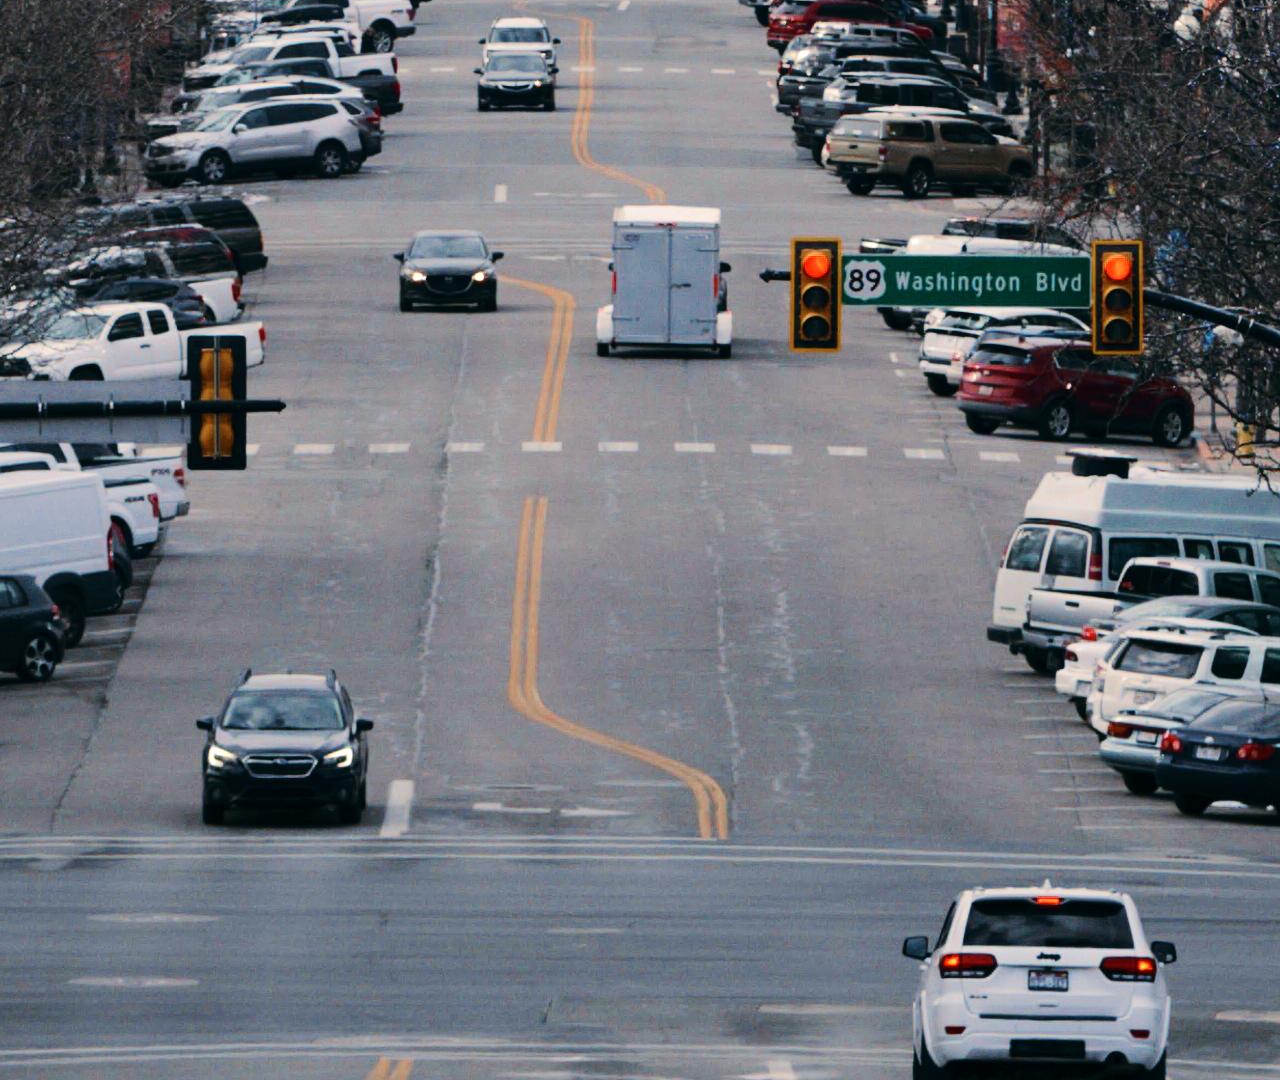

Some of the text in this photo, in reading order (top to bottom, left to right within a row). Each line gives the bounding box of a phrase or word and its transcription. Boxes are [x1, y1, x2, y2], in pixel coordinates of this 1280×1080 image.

[849, 268, 1082, 298] 89 Washington Blvd
